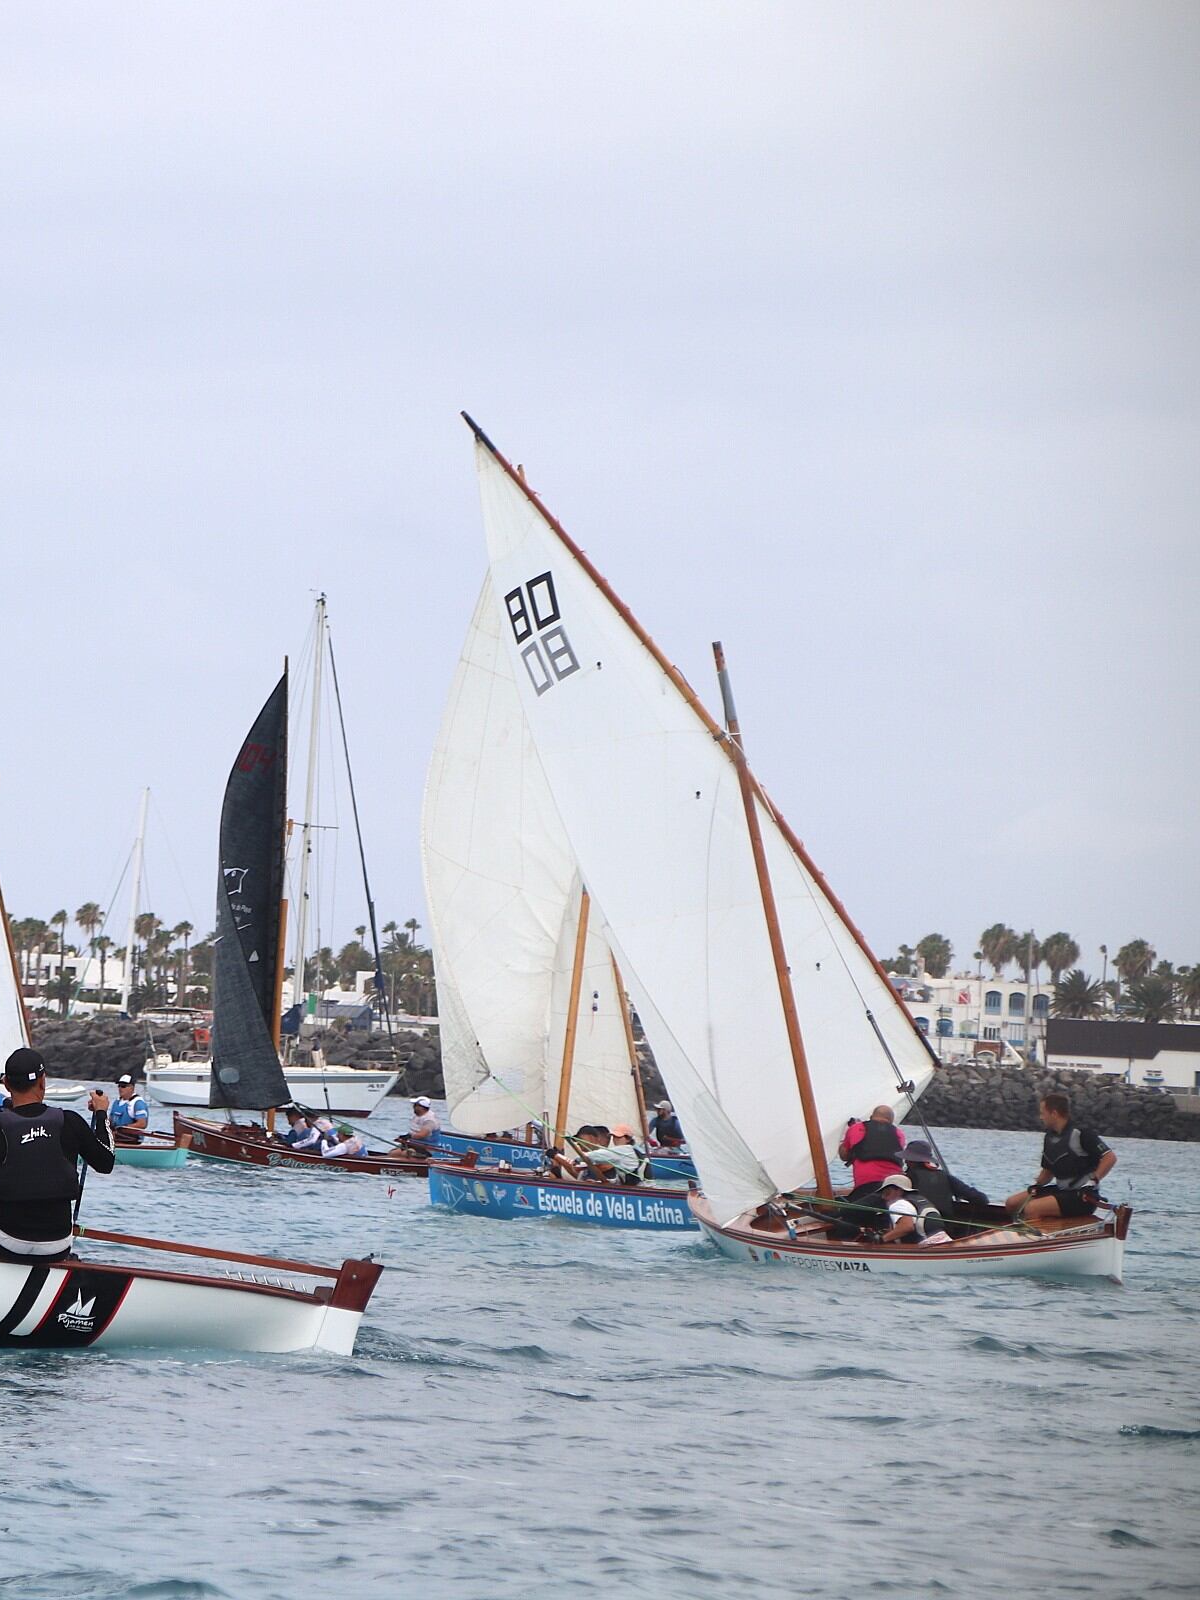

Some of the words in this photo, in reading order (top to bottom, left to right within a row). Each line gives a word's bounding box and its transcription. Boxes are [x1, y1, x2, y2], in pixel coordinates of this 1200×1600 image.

[504, 570, 561, 645] 80
[537, 1188, 585, 1216] Escuela
[586, 1193, 603, 1218] de
[605, 1195, 636, 1221] Vela
[638, 1199, 685, 1225] Latina
